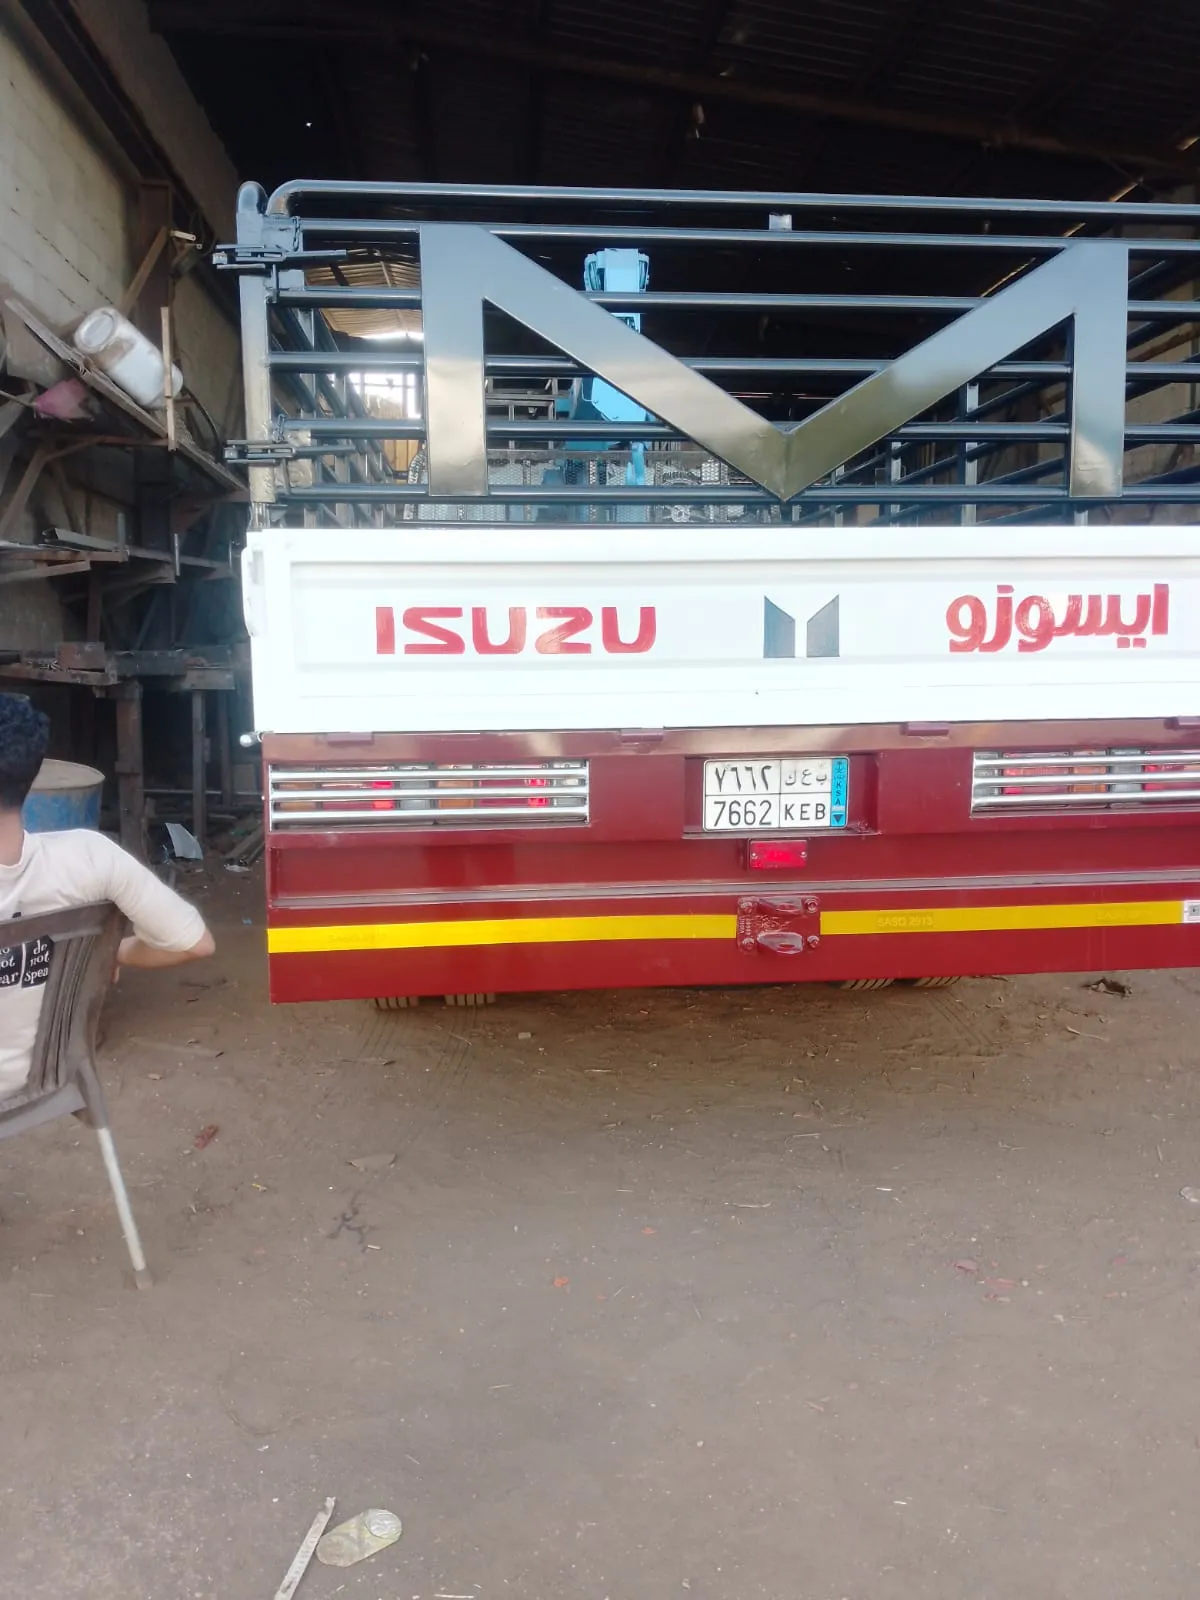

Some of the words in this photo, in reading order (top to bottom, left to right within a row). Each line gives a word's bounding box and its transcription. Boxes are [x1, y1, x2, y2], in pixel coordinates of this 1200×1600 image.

[376, 606, 656, 654] ISUZU
[946, 583, 1169, 653] ايسوزو
[713, 800, 772, 827] 7662
[784, 803, 826, 821] KEB
